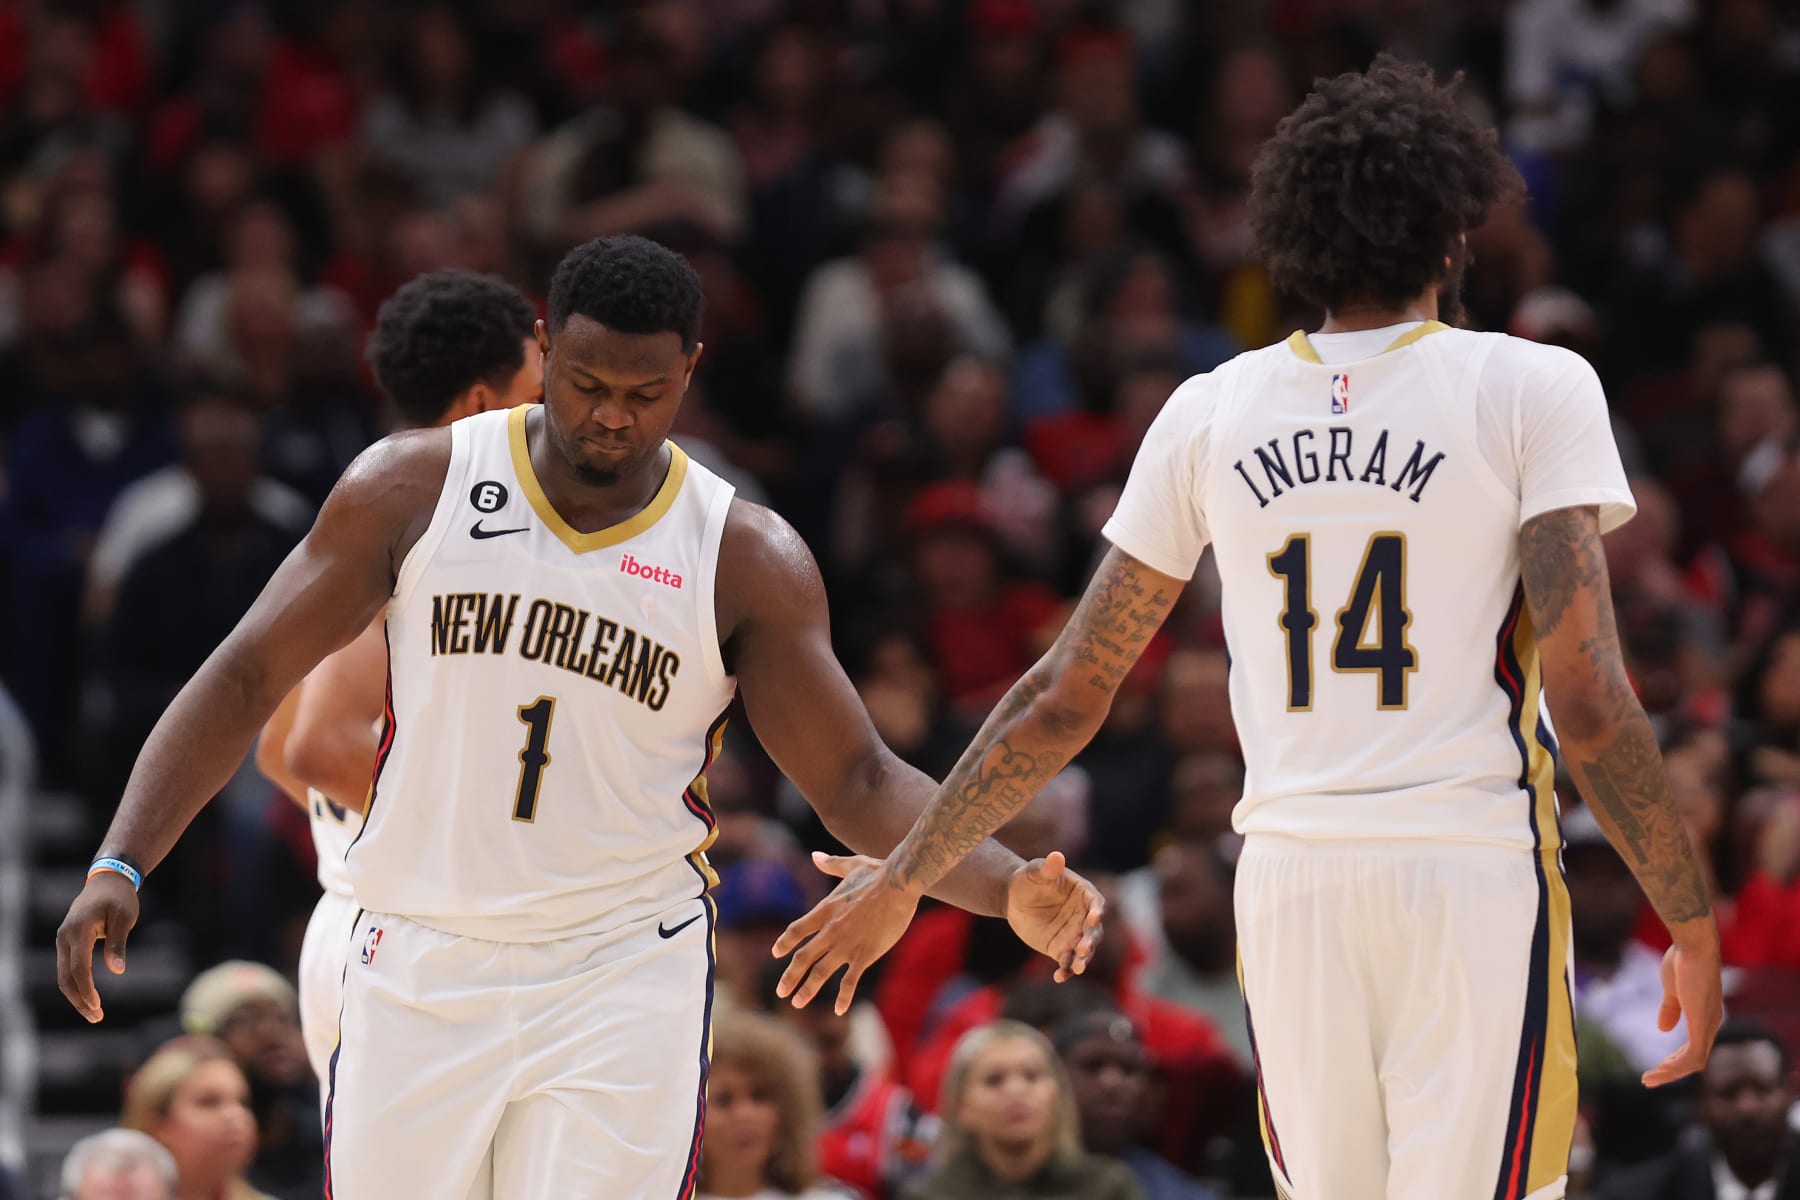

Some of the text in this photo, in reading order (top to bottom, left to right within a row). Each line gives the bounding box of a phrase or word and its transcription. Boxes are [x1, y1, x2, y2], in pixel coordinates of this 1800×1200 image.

[477, 484, 500, 510] 6
[1233, 426, 1446, 508] INGRAM
[620, 553, 683, 589] ibotta
[1266, 530, 1419, 712] 14
[431, 593, 681, 712] NEW ORLEANS
[512, 695, 557, 824] 1
